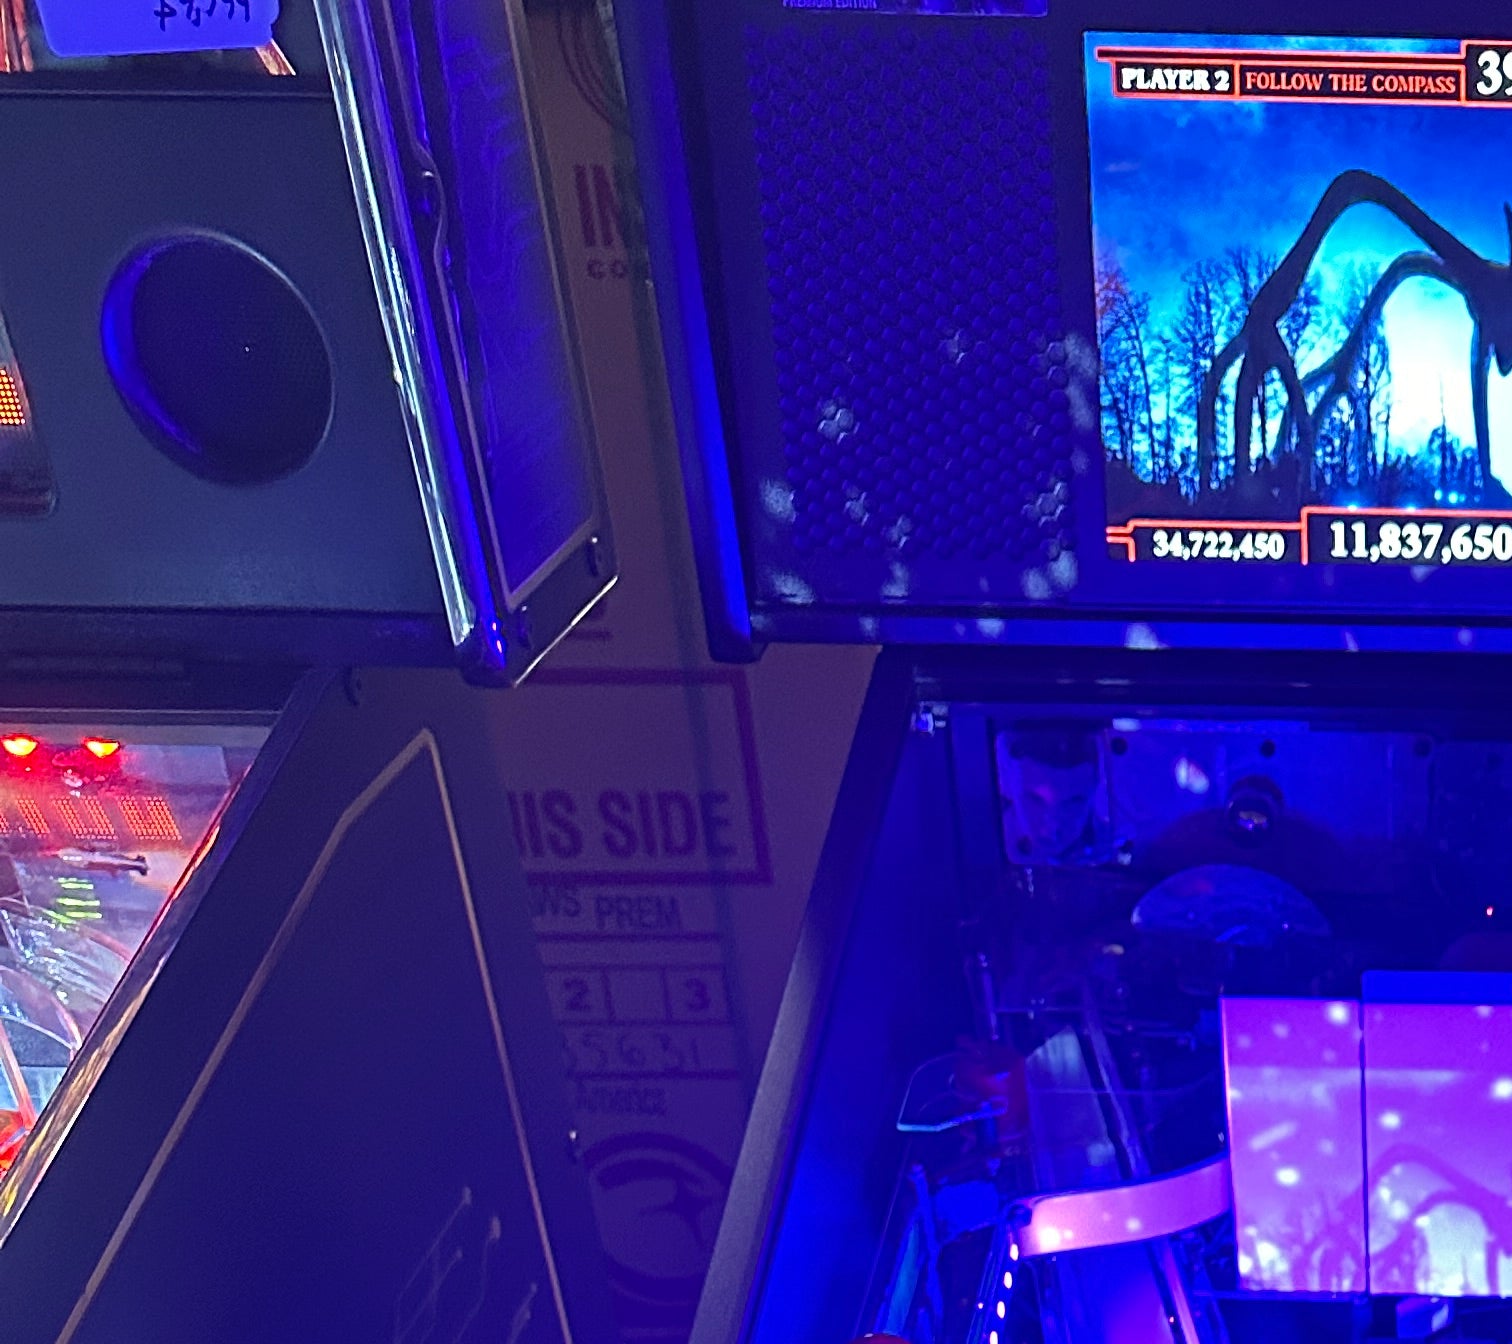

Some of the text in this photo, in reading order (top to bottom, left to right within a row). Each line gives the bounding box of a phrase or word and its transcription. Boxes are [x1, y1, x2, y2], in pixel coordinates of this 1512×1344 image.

[1121, 68, 1230, 91] PLAYER 2
[1245, 72, 1457, 95] FOLLOW THE COMPASS
[1152, 530, 1285, 562] 34,722,450
[598, 789, 739, 858] SIDE
[562, 976, 593, 1012] 2
[682, 976, 712, 1012] 3
